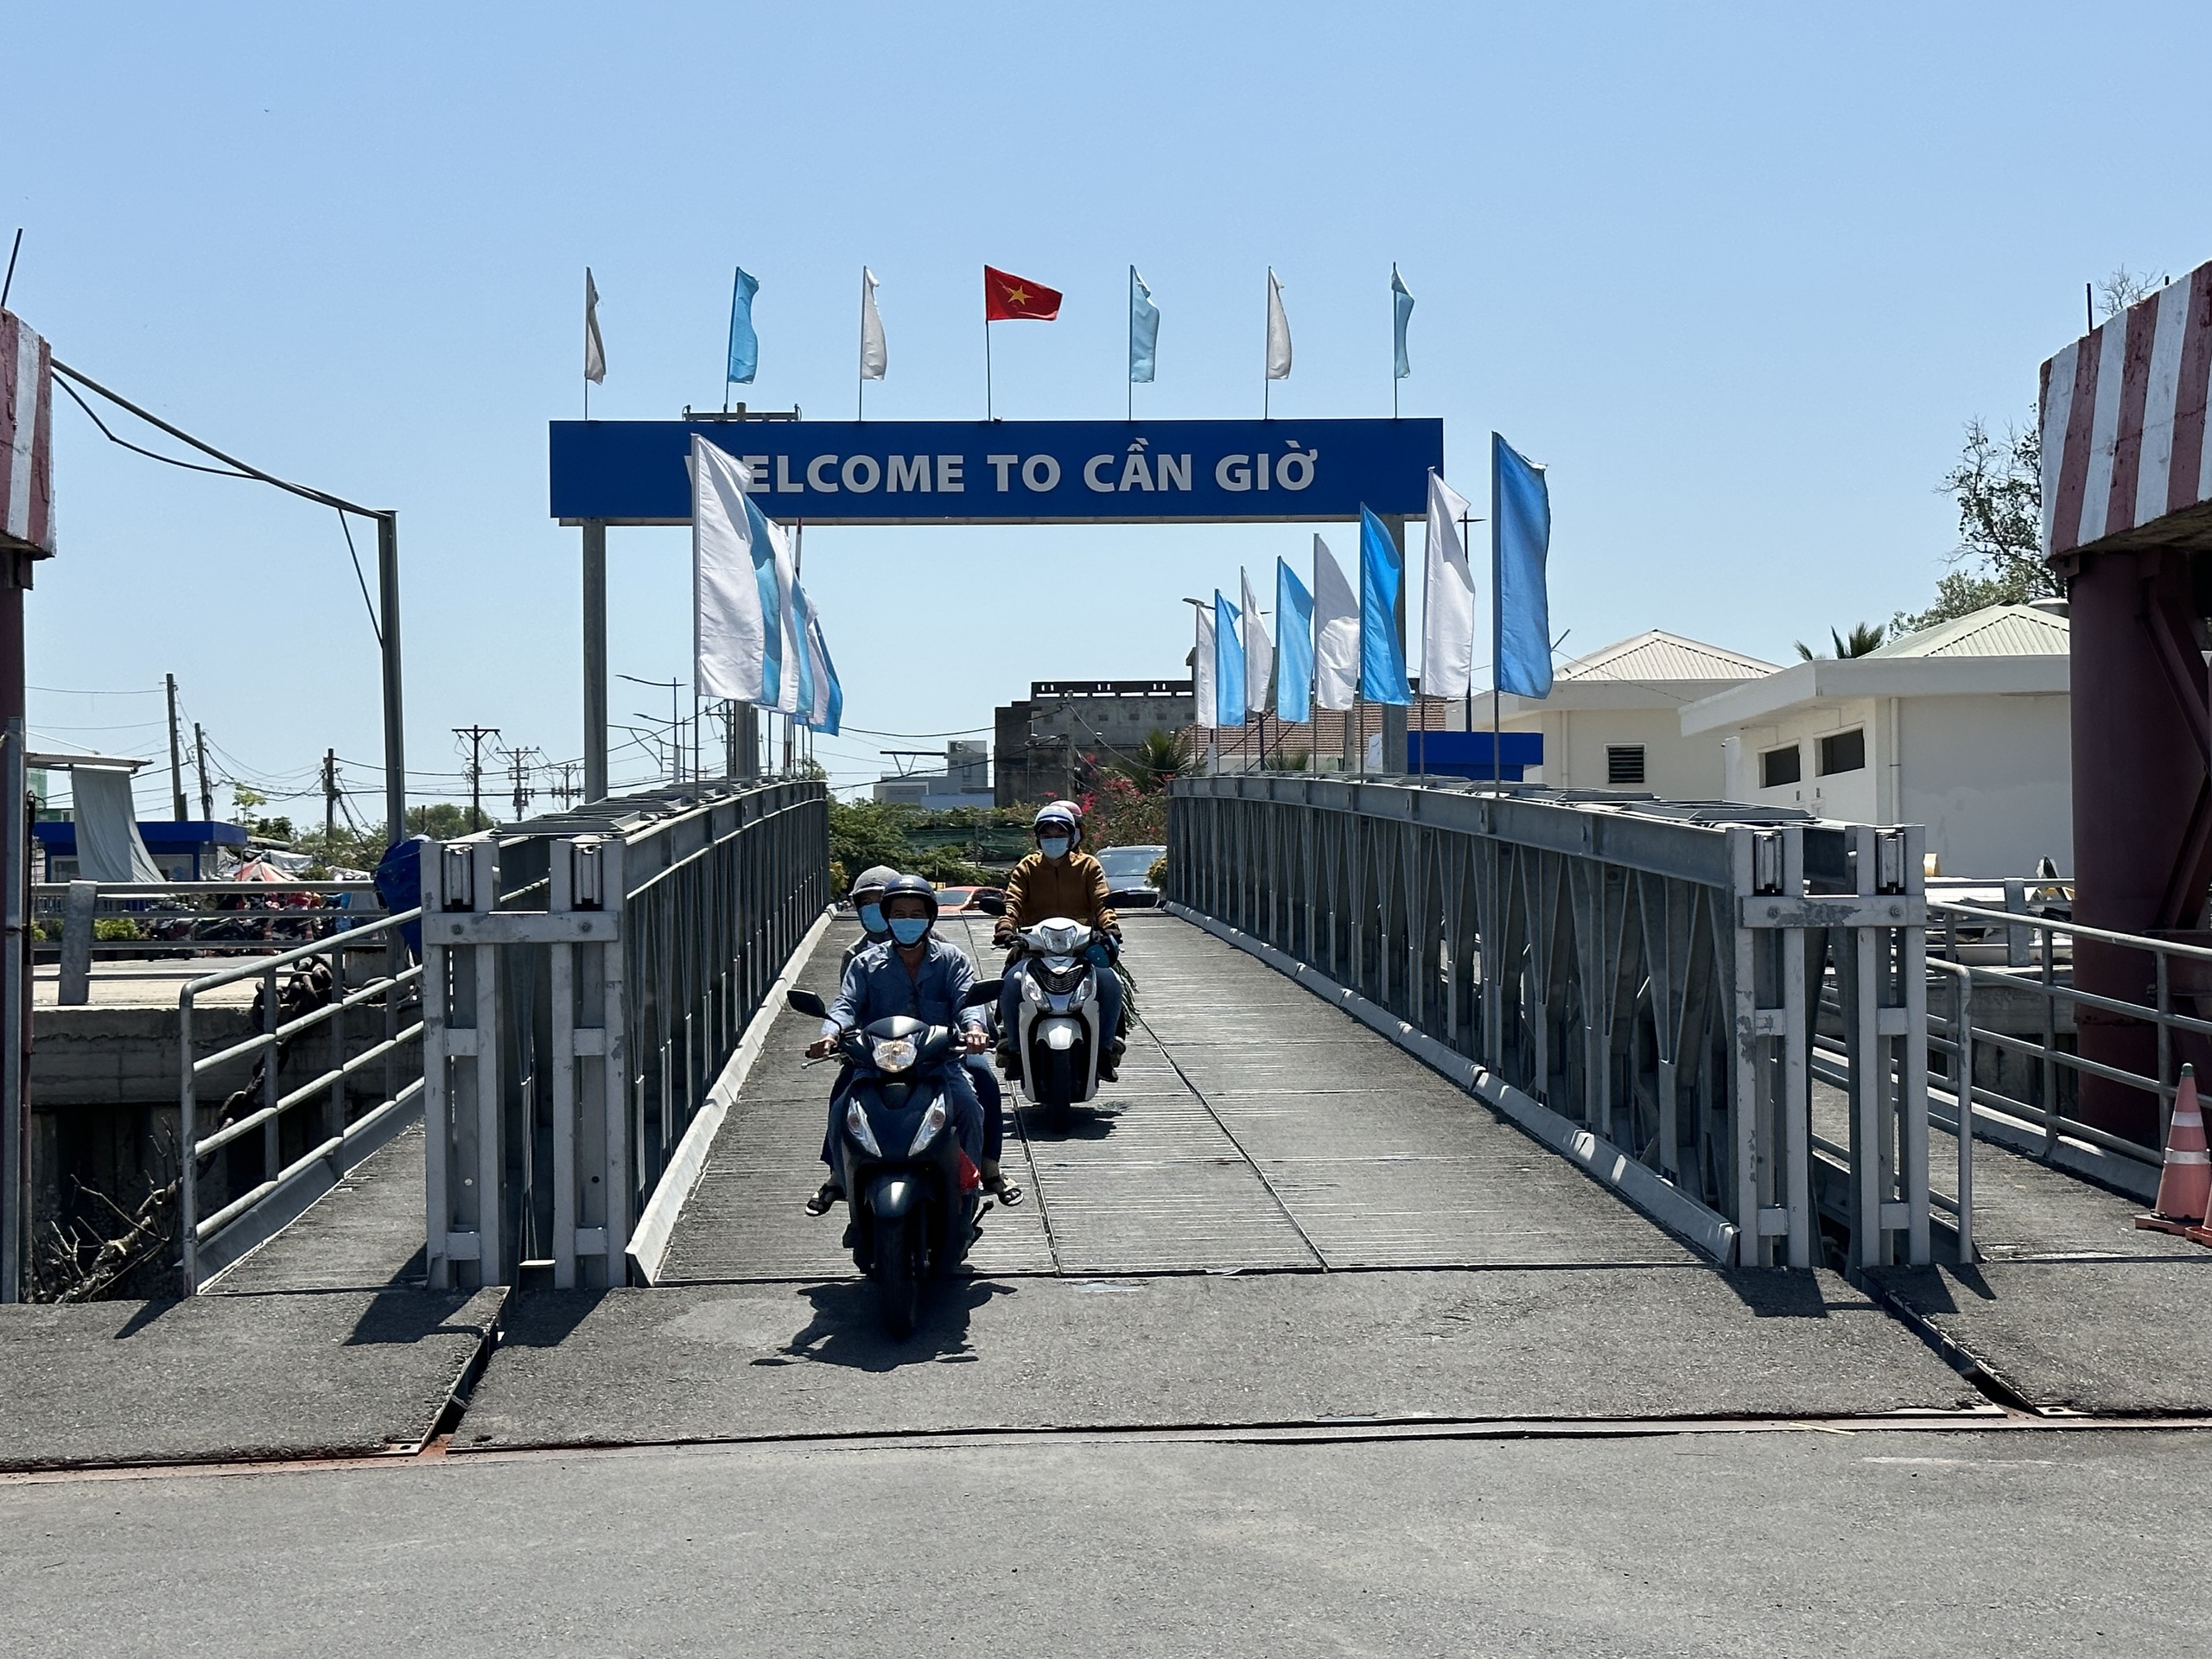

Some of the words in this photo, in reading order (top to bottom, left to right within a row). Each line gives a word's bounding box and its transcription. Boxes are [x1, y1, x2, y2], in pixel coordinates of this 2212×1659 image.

[684, 454, 964, 493] ELCOME
[987, 454, 1061, 493] TO
[1084, 437, 1192, 493] CẦN
[1215, 440, 1318, 492] GIỜ
